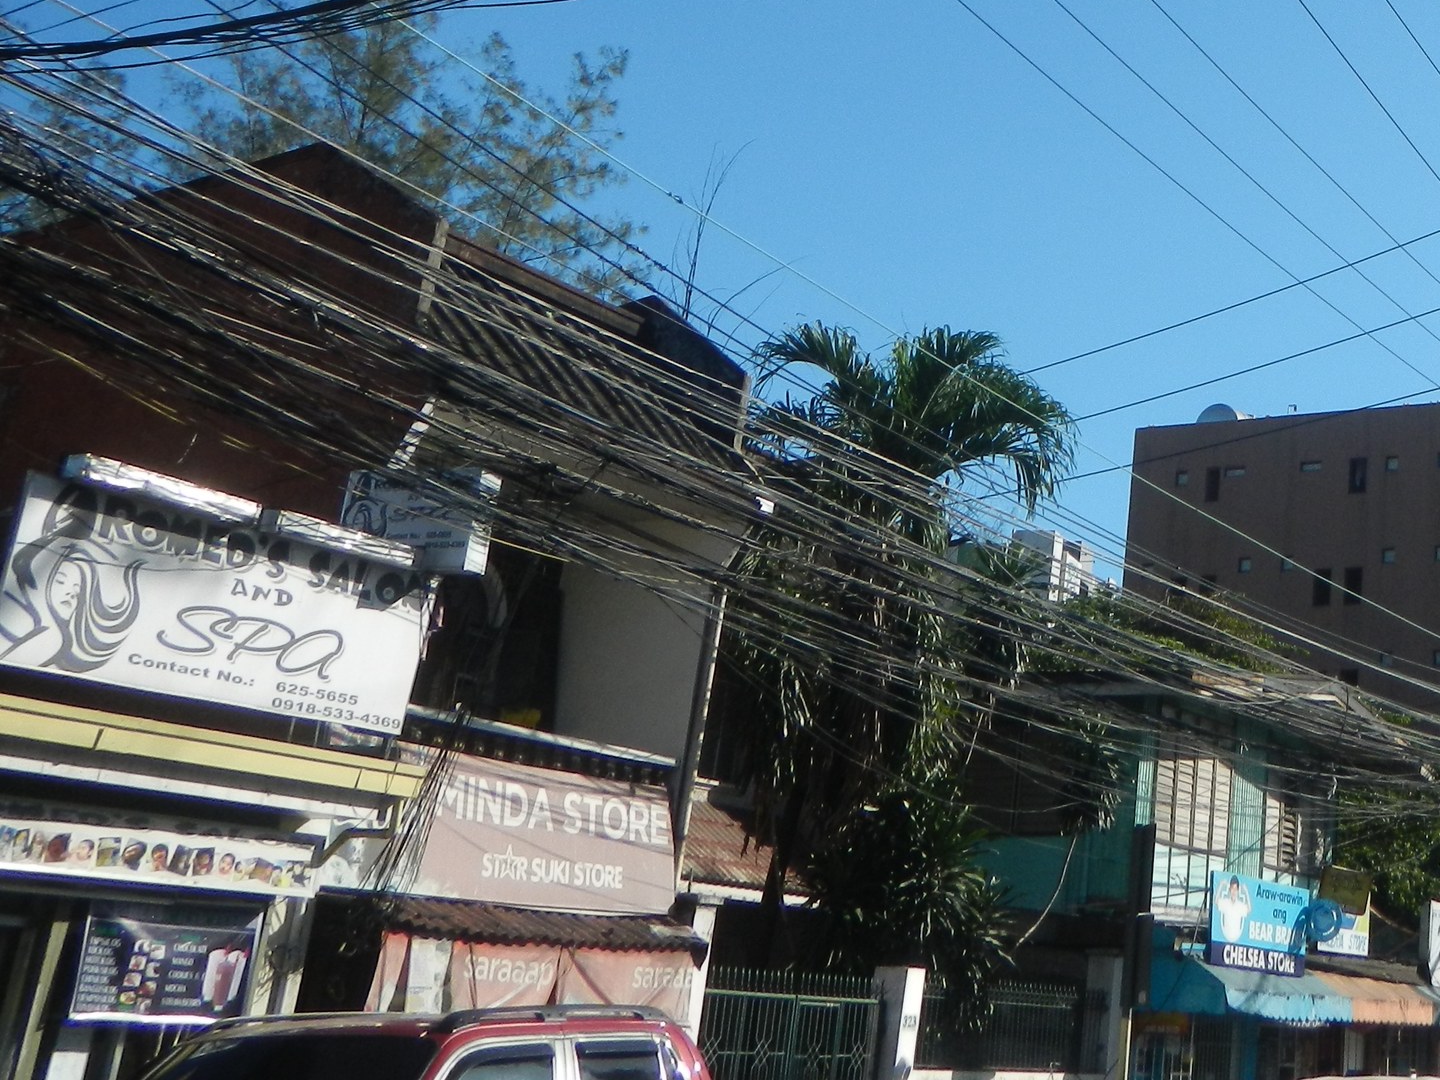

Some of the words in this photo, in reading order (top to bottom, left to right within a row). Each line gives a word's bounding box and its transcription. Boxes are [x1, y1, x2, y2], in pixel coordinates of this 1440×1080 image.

[231, 577, 293, 607] AND
[157, 605, 344, 681] SPA
[127, 653, 211, 679] Contact
[216, 670, 255, 687] No.:
[275, 681, 359, 706] 625-5655
[271, 696, 402, 729] 0918-533-4369
[437, 774, 555, 832] MINDA
[563, 791, 670, 845] STORE
[531, 857, 571, 884] SUKI
[573, 863, 624, 889] STORE
[1272, 905, 1287, 924] ang
[1249, 921, 1274, 942] BEAR
[462, 952, 554, 993] saraaap
[1223, 945, 1266, 969] CHELSEA
[1267, 951, 1295, 974] STORE
